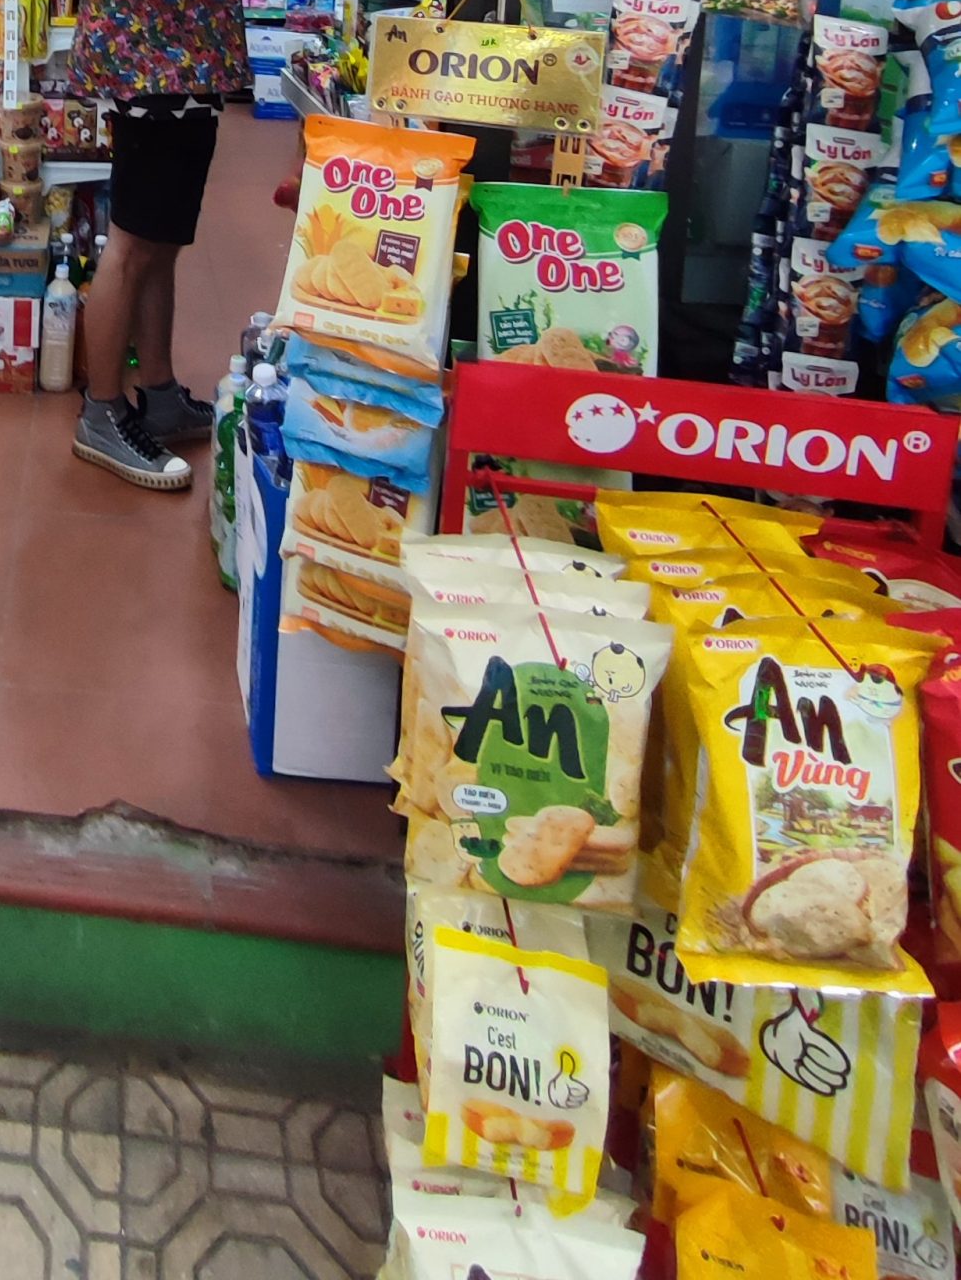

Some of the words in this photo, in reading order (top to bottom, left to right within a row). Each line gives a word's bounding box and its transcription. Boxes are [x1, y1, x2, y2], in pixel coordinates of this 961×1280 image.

[409, 48, 540, 86] ORION
[434, 90, 464, 105] GẠO
[467, 93, 532, 112] THƯỢNG
[534, 100, 580, 117] HẠNG
[321, 154, 396, 192] One
[350, 188, 426, 221] One
[495, 219, 585, 264] One
[535, 253, 626, 293] One
[658, 412, 898, 482] ORION
[662, 565, 698, 575] ORION
[457, 630, 498, 643] ORION
[715, 640, 754, 650] ORION
[441, 655, 586, 780] An
[725, 656, 852, 768] An
[487, 1007, 527, 1022] ORION
[487, 1024, 517, 1049] C'est
[464, 1045, 542, 1105] BON!
[429, 1228, 467, 1245] ORION
